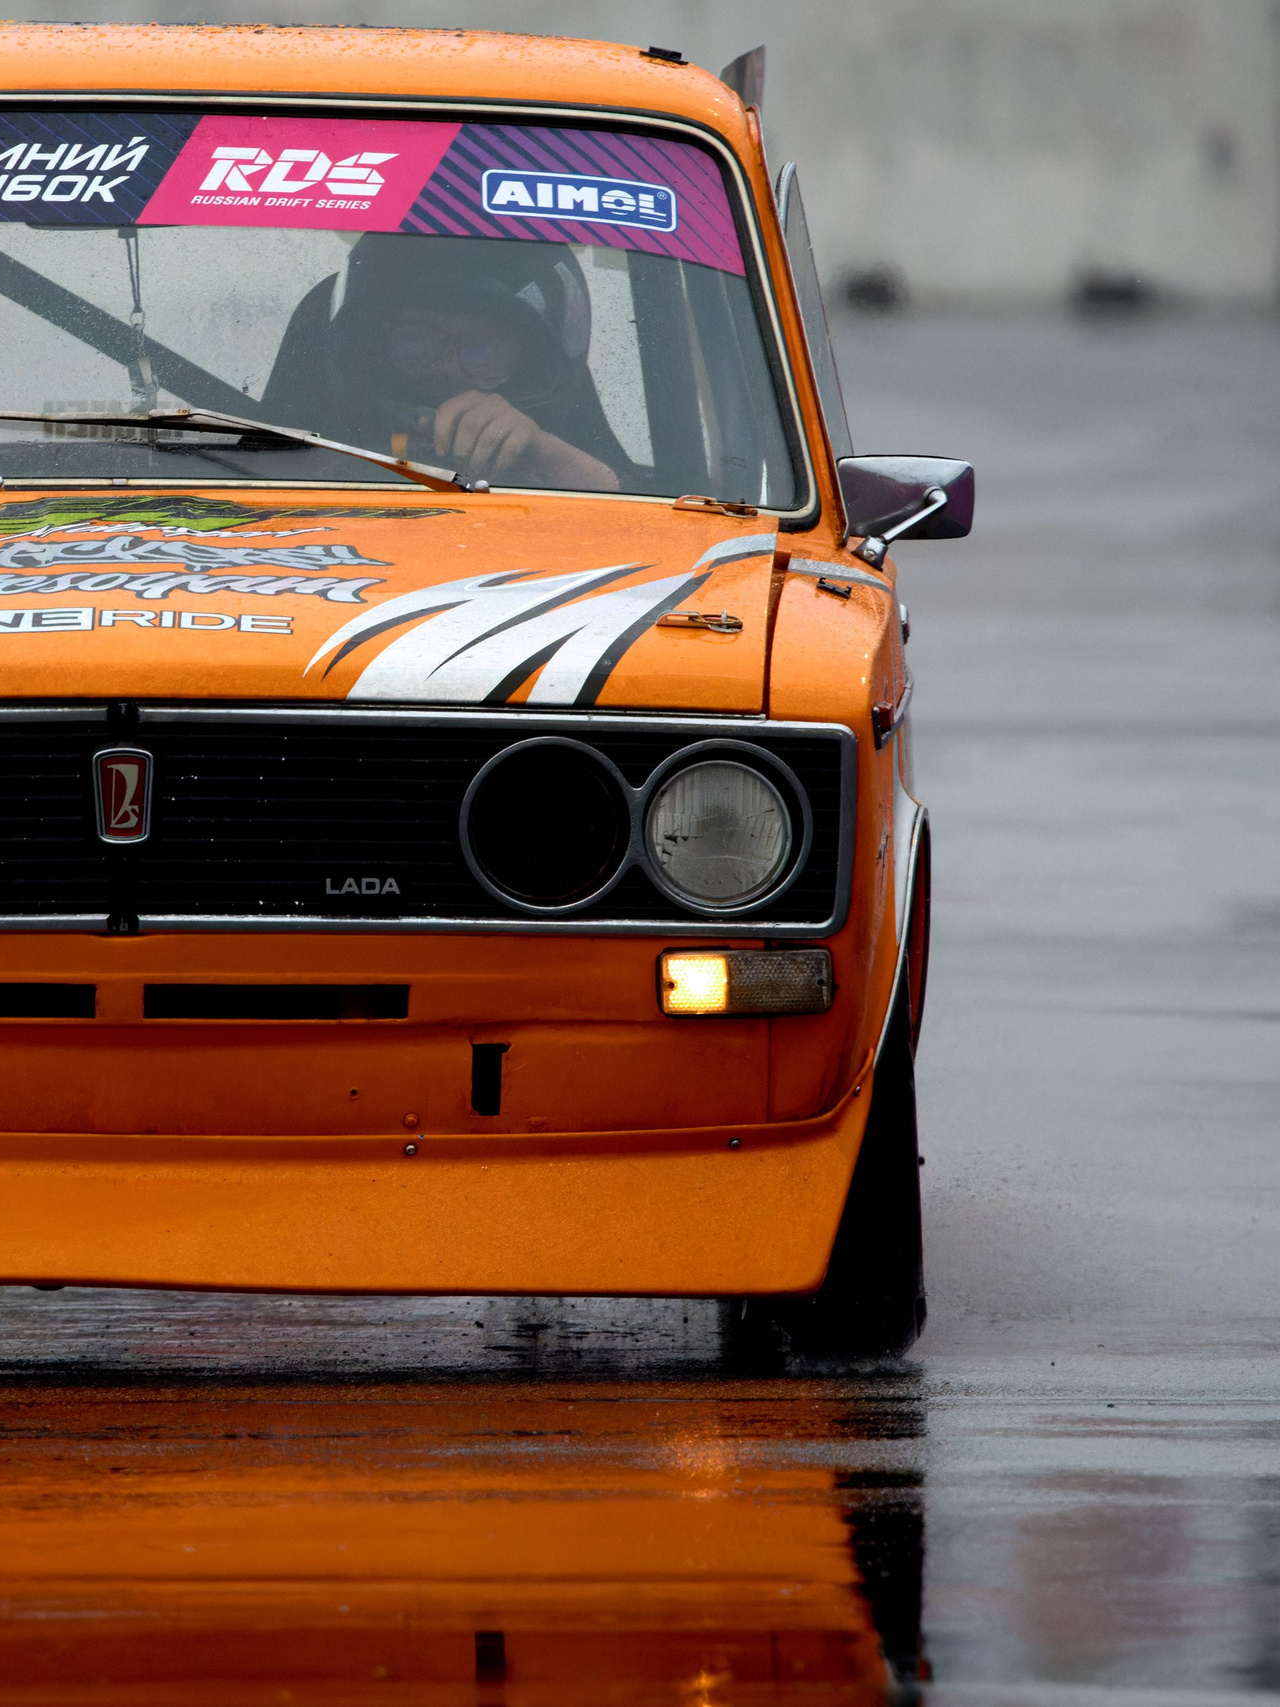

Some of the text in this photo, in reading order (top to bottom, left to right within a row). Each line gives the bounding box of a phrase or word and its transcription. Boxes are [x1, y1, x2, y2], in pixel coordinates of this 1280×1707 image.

[198, 146, 401, 197] RDS
[190, 194, 372, 211] RUSSIAN DRIFT SERIES
[491, 180, 668, 223] AIMOL
[325, 877, 401, 895] LADA
